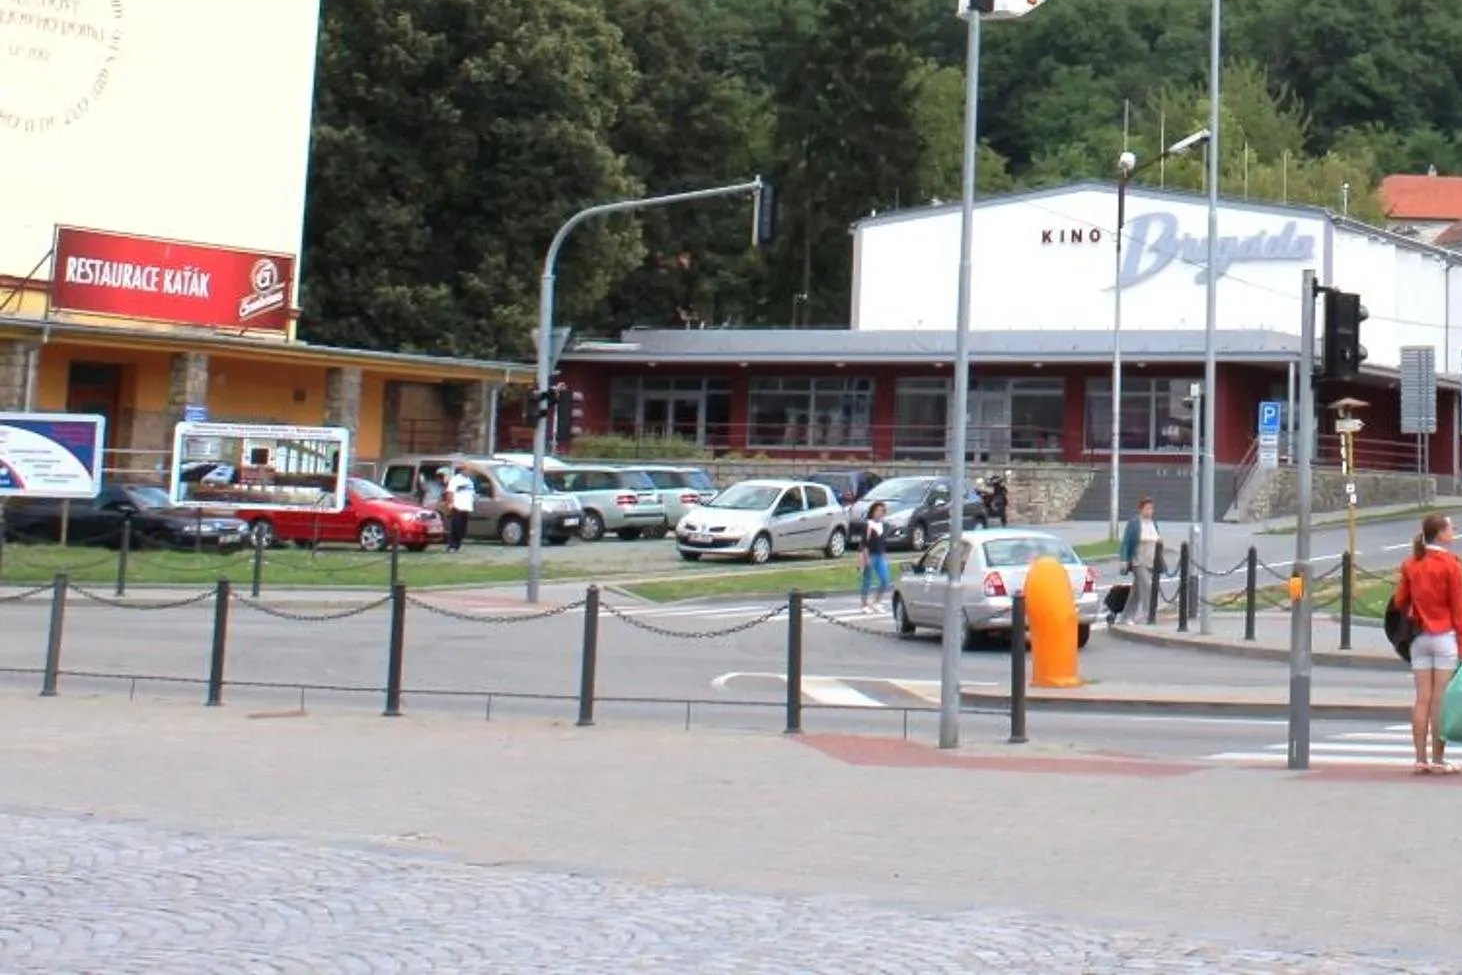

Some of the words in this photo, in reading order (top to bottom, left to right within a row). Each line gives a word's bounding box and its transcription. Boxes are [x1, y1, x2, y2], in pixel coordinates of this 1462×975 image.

[1042, 228, 1102, 243] KINO
[65, 256, 161, 293] RESTAURACE
[163, 265, 212, 298] KAŤÁK
[1263, 406, 1276, 424] P
